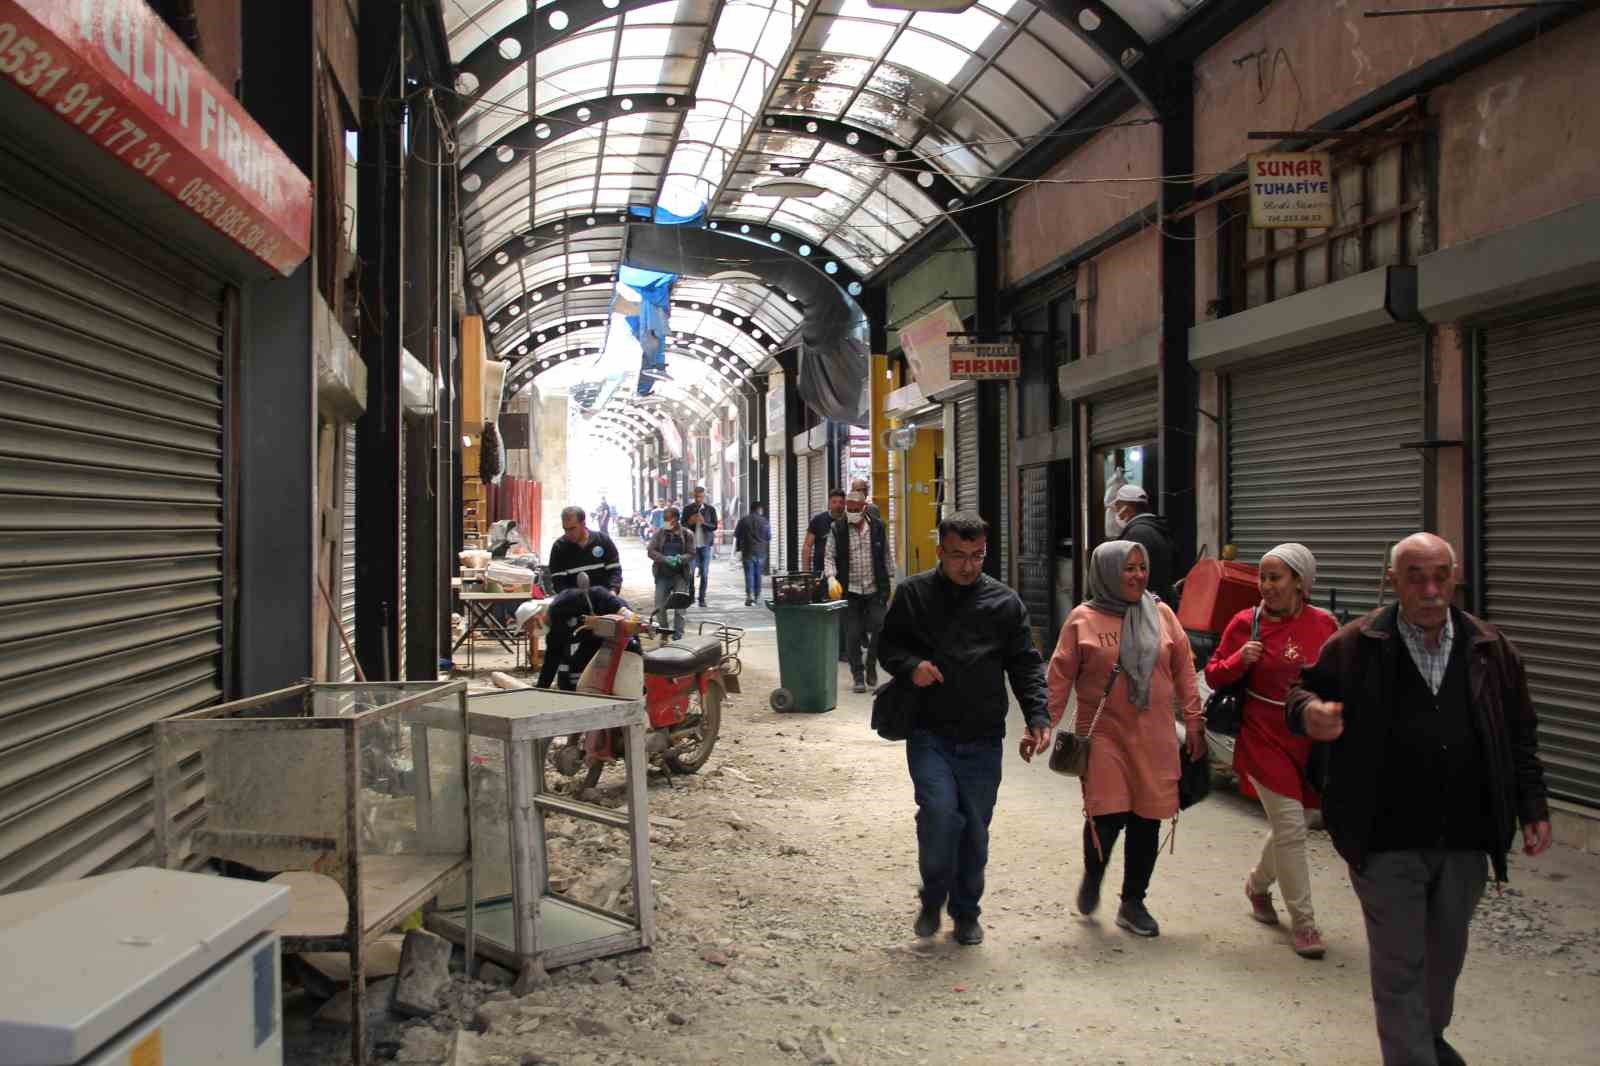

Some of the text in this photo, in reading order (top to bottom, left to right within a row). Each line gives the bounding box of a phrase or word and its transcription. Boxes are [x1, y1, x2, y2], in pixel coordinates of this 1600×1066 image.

[0, 22, 69, 97] 0531
[56, 82, 117, 134] 911
[104, 118, 147, 156] 77
[132, 142, 172, 177] 31
[1256, 160, 1323, 176] SUNAR
[952, 359, 1018, 373] FIRINI
